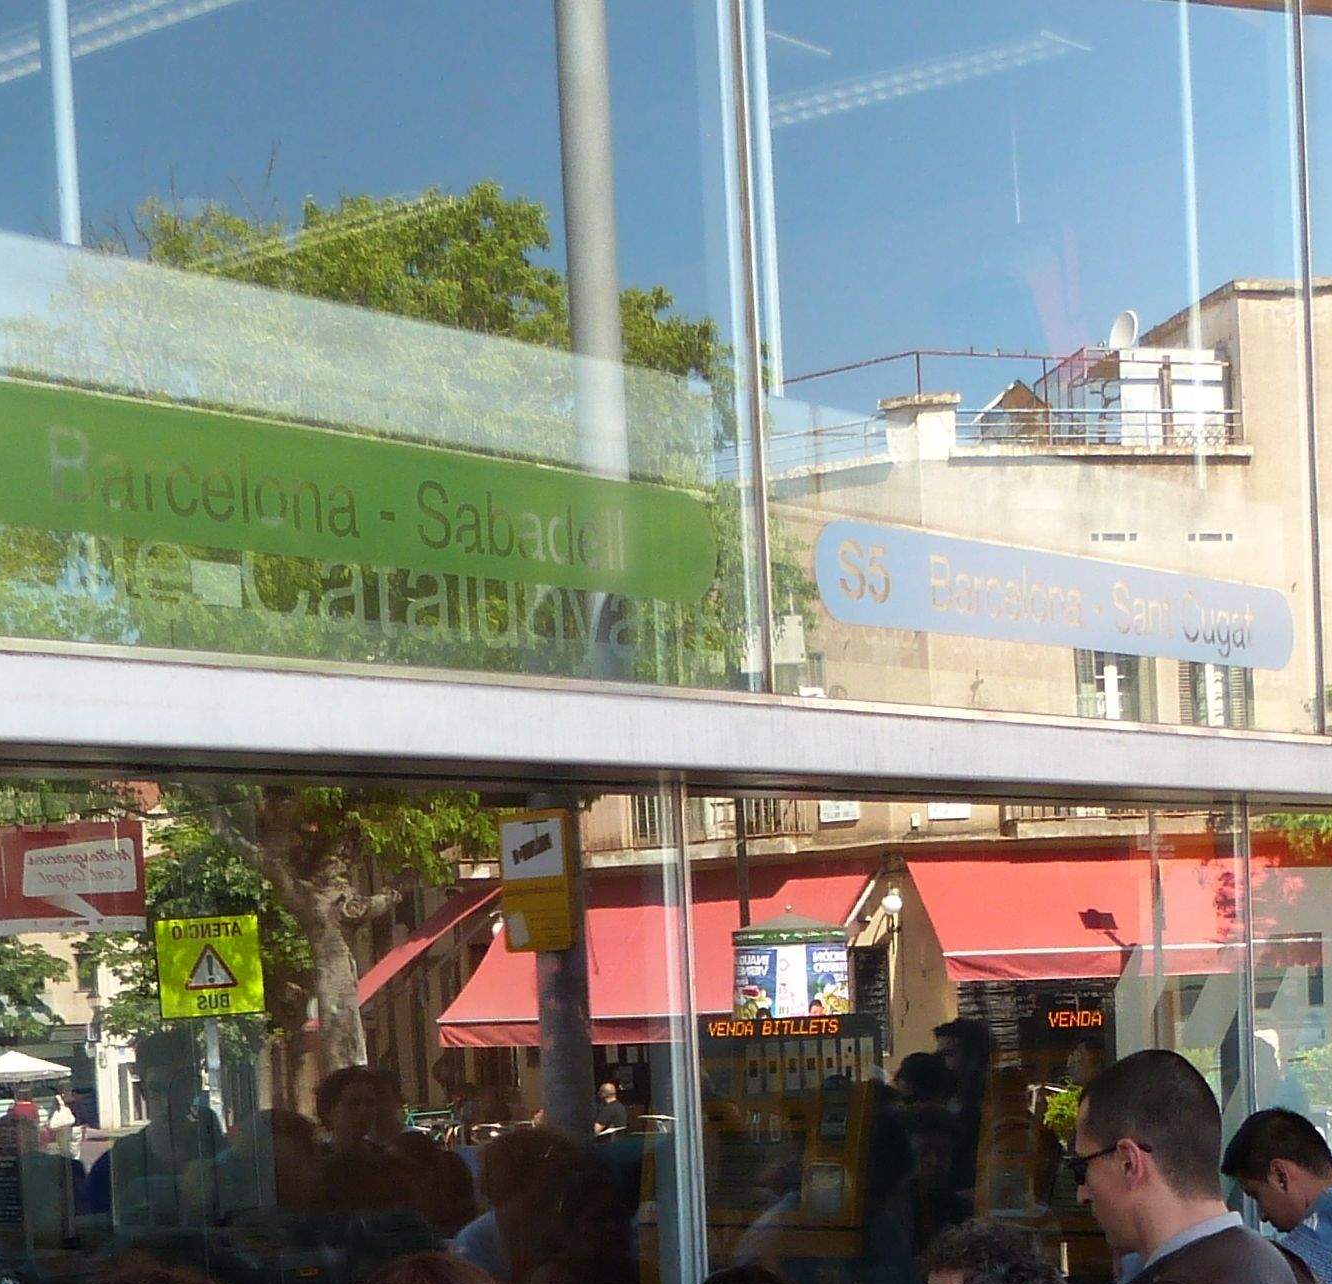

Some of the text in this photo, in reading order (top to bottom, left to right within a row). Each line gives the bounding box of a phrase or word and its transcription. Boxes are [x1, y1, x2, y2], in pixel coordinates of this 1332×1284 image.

[48, 422, 360, 538] Barcelona
[416, 479, 628, 573] Sabadell
[838, 539, 893, 605] S5
[930, 554, 1086, 630] Barcelona
[1114, 579, 1177, 638] Sant
[1181, 593, 1257, 669] Cugat
[707, 1019, 839, 1038] VENDA BITLLETS
[1048, 1010, 1103, 1030] VENDA
